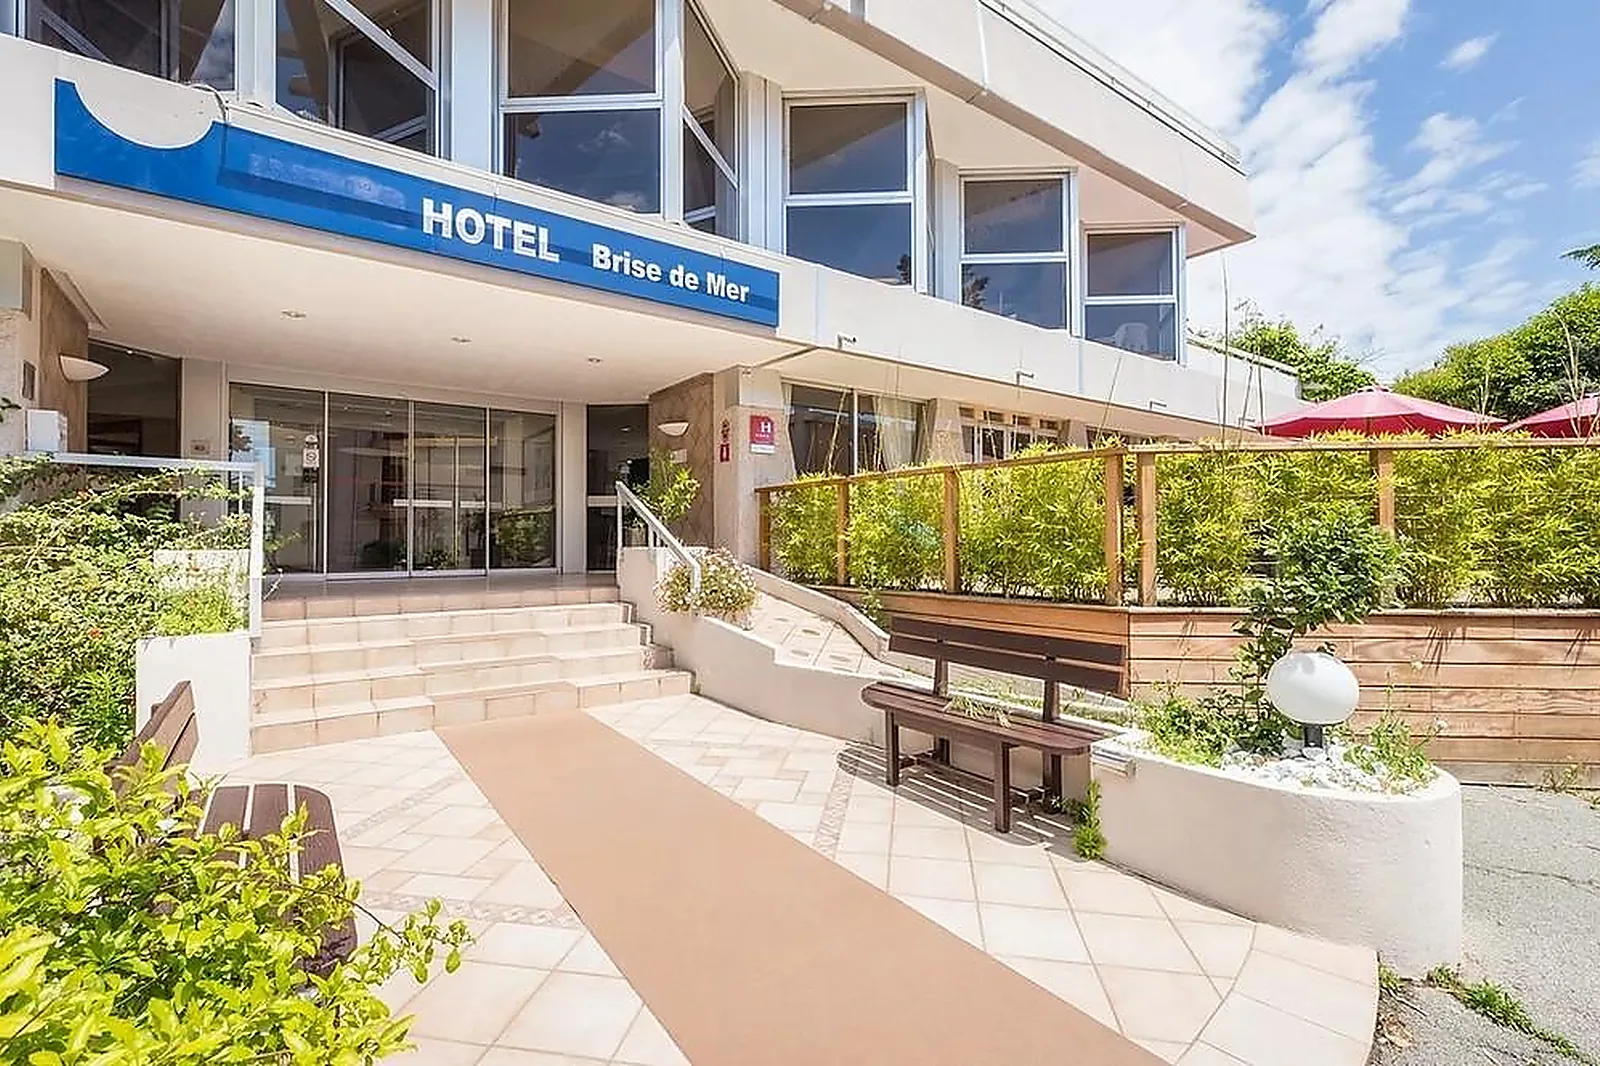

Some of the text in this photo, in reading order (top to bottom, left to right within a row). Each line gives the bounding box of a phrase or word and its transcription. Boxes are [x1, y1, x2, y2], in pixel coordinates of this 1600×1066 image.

[422, 197, 750, 303] HOTEL Brise de Mer
[760, 421, 772, 433] H
